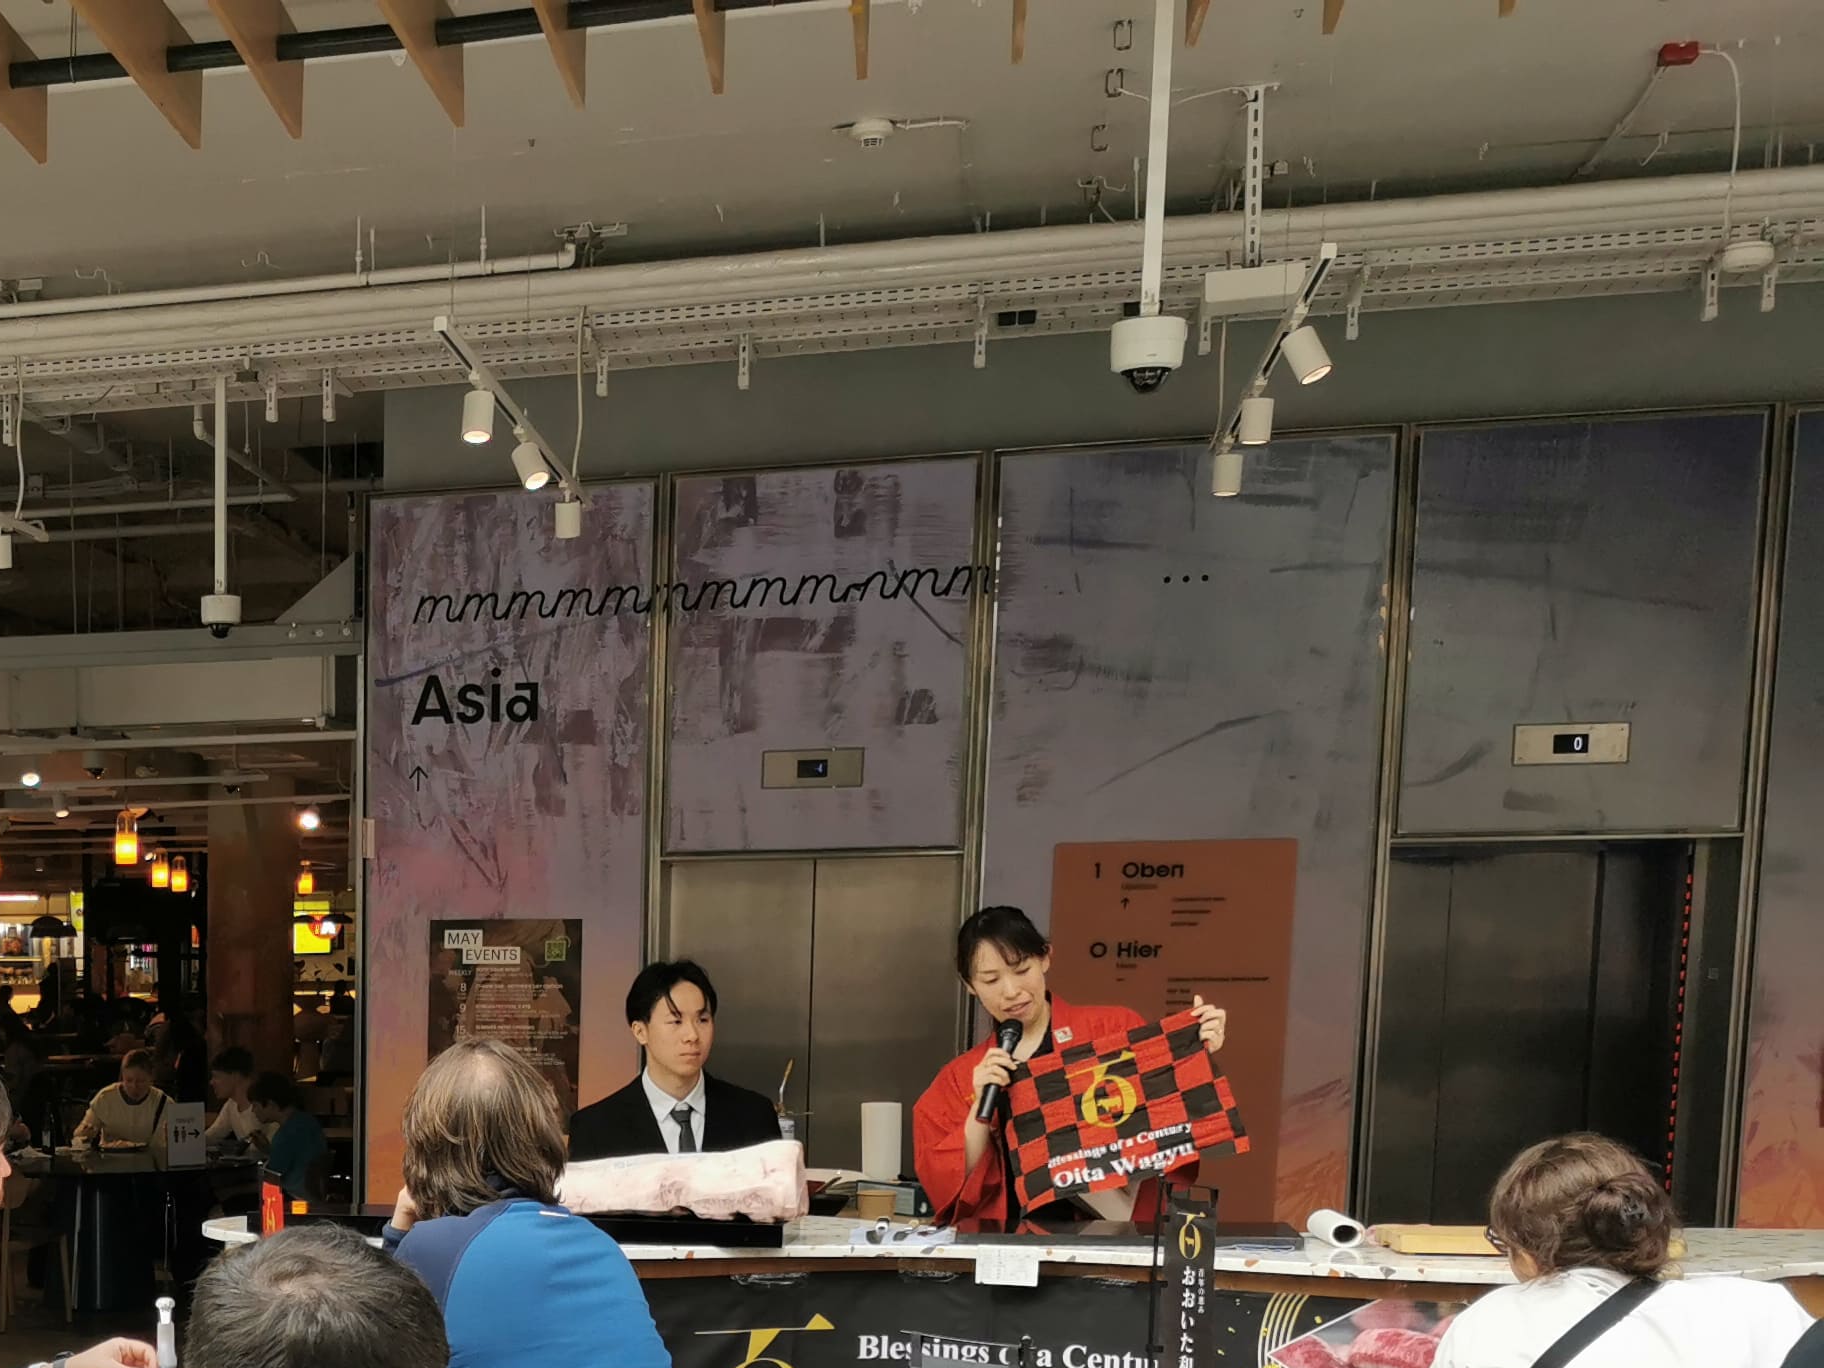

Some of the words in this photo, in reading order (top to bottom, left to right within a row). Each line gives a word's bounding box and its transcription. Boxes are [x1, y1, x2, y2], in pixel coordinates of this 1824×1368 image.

[411, 667, 540, 726] Asia
[1573, 736, 1583, 751] 0
[1094, 862, 1102, 879] 1
[1122, 862, 1185, 879] Oben
[447, 932, 480, 945] MAY
[466, 949, 518, 961] EVENTS
[1116, 940, 1163, 958] Hier
[460, 983, 467, 992] 8
[459, 1004, 466, 1012] 9
[1053, 1167, 1106, 1188] Oita
[1110, 1142, 1195, 1176] Wagyu
